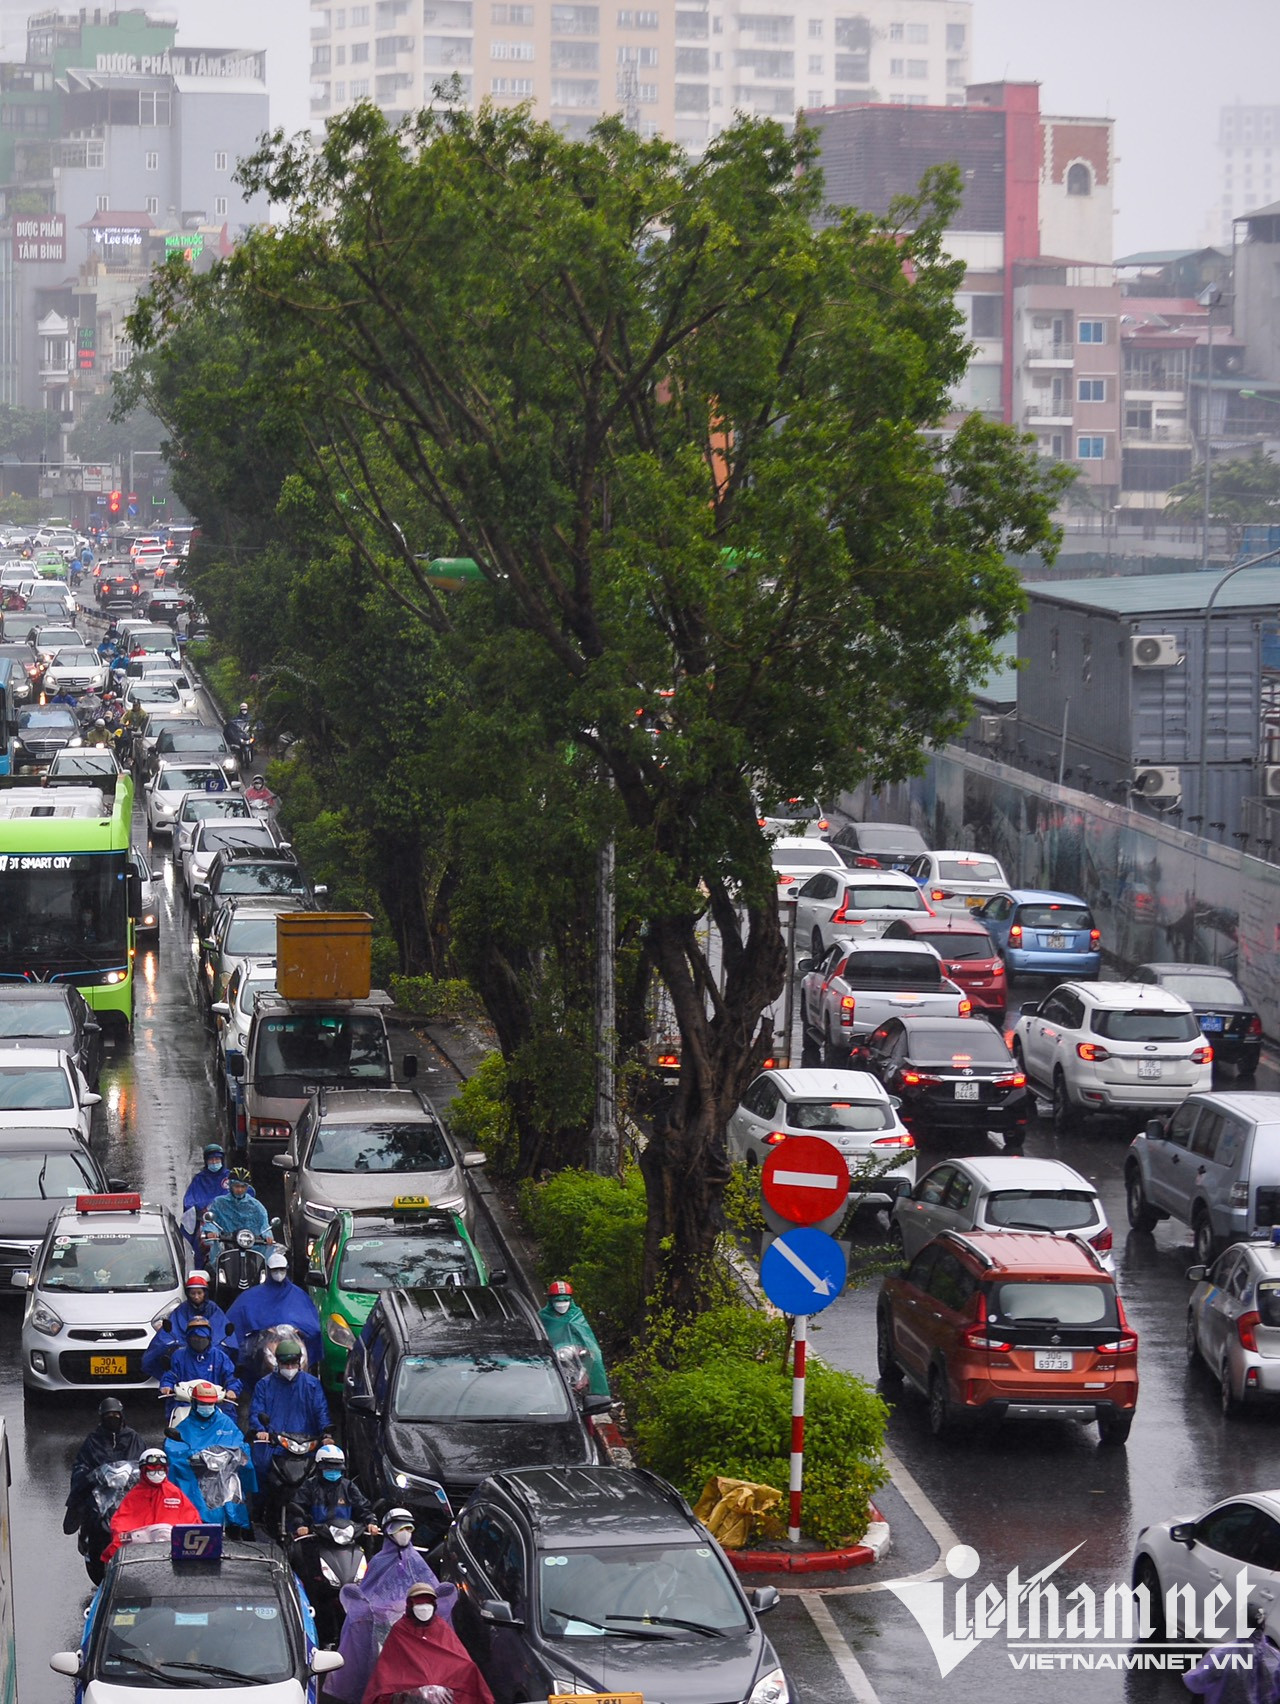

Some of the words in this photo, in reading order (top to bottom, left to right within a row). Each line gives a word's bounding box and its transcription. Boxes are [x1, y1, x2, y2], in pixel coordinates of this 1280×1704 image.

[16, 219, 39, 240] DƯỢC
[40, 215, 63, 237] PHẨM
[122, 233, 142, 247] style
[18, 240, 38, 259] TÂM
[40, 241, 63, 259] BÌNH
[21, 857, 52, 870] SMART
[53, 857, 71, 869] CITY
[100, 1357, 116, 1366] 30A
[1039, 1360, 1068, 1369] 697.38
[94, 1365, 123, 1374] 805.74
[183, 1529, 210, 1556] G7
